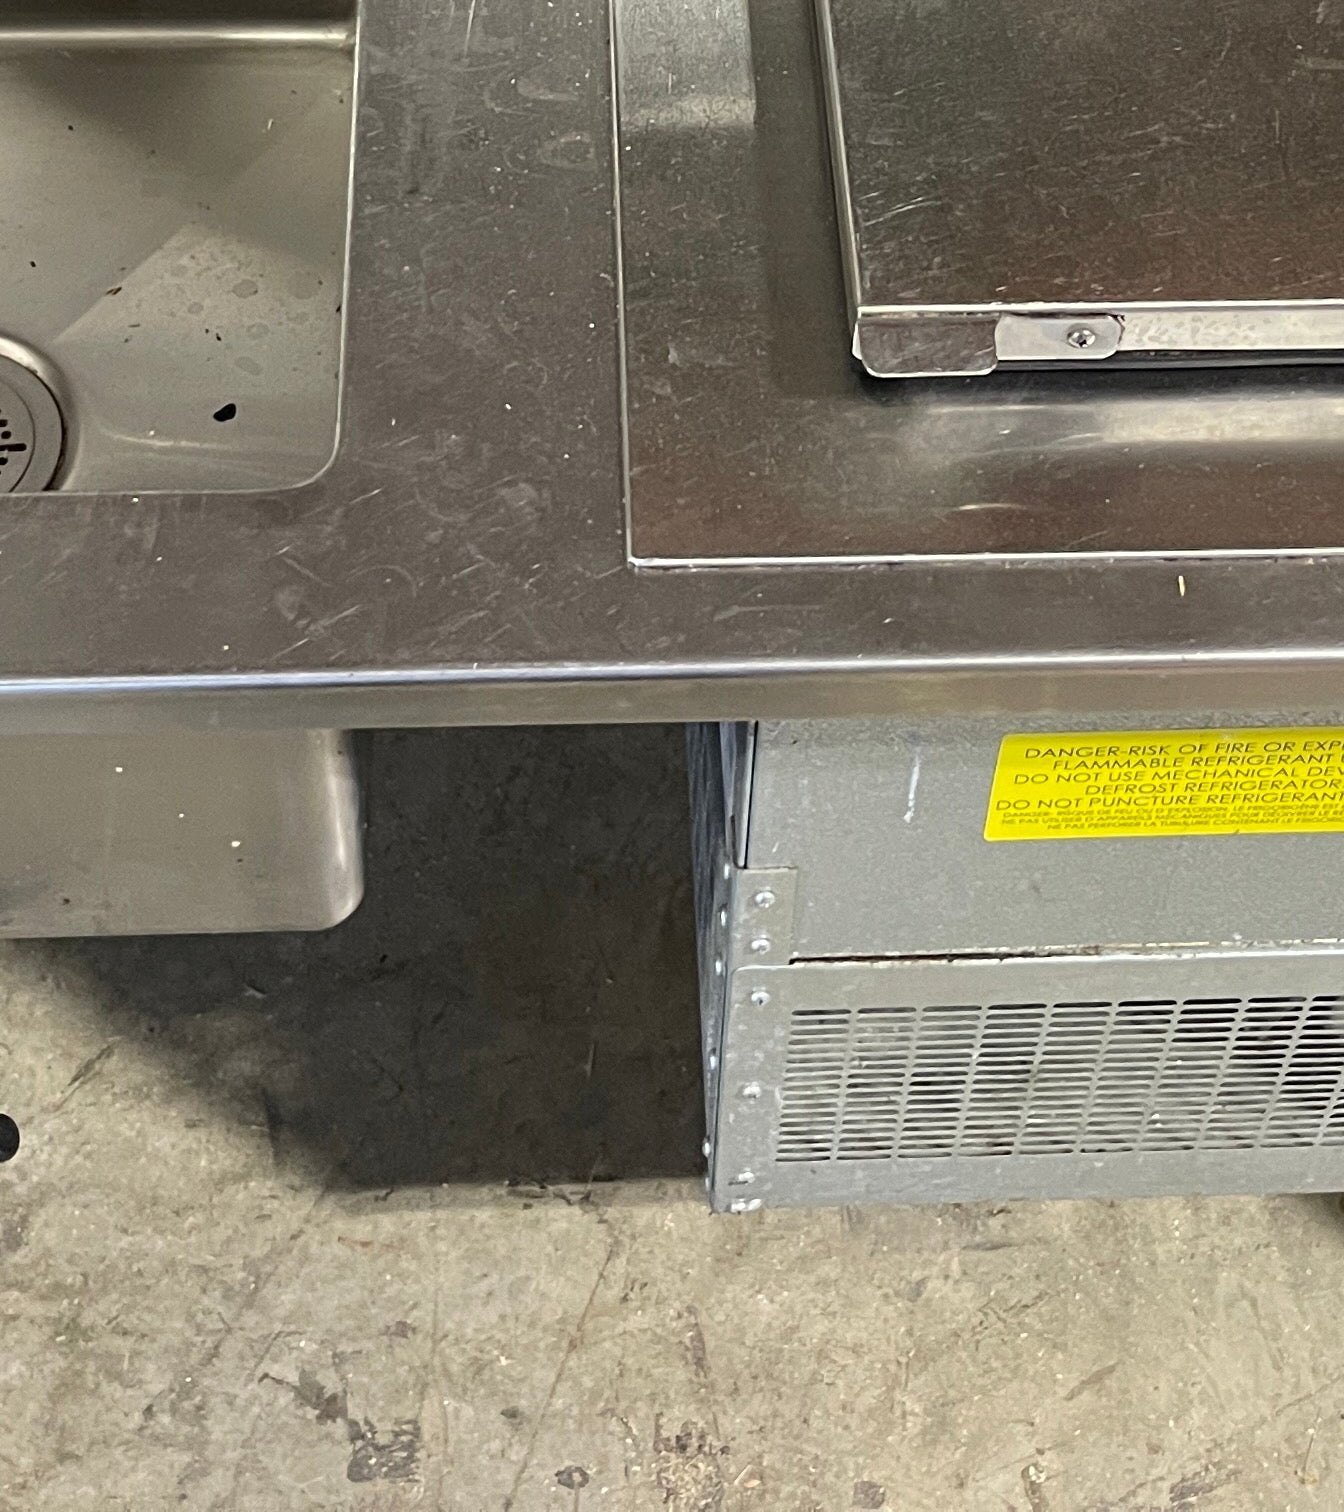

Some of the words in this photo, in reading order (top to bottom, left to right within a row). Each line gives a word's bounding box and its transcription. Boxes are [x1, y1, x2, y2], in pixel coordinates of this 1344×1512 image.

[1025, 744, 1172, 759] DANGER-RISK
[1179, 744, 1209, 755] OF
[1214, 742, 1256, 754] FIRE
[1264, 741, 1296, 752] OR
[1053, 756, 1186, 771] FLAMMABLE
[1191, 752, 1335, 767] REFRIGERANT
[1014, 773, 1049, 785] DO
[1056, 772, 1101, 783] NOT
[1108, 771, 1146, 782] USE
[1152, 767, 1299, 780] MECHANICAL
[1085, 782, 1178, 796] DEFROST
[996, 799, 1030, 811] DO
[1038, 798, 1082, 809] NOT
[1089, 795, 1202, 808] PUNCTURE
[1207, 792, 1344, 805] REFRIGERANT
